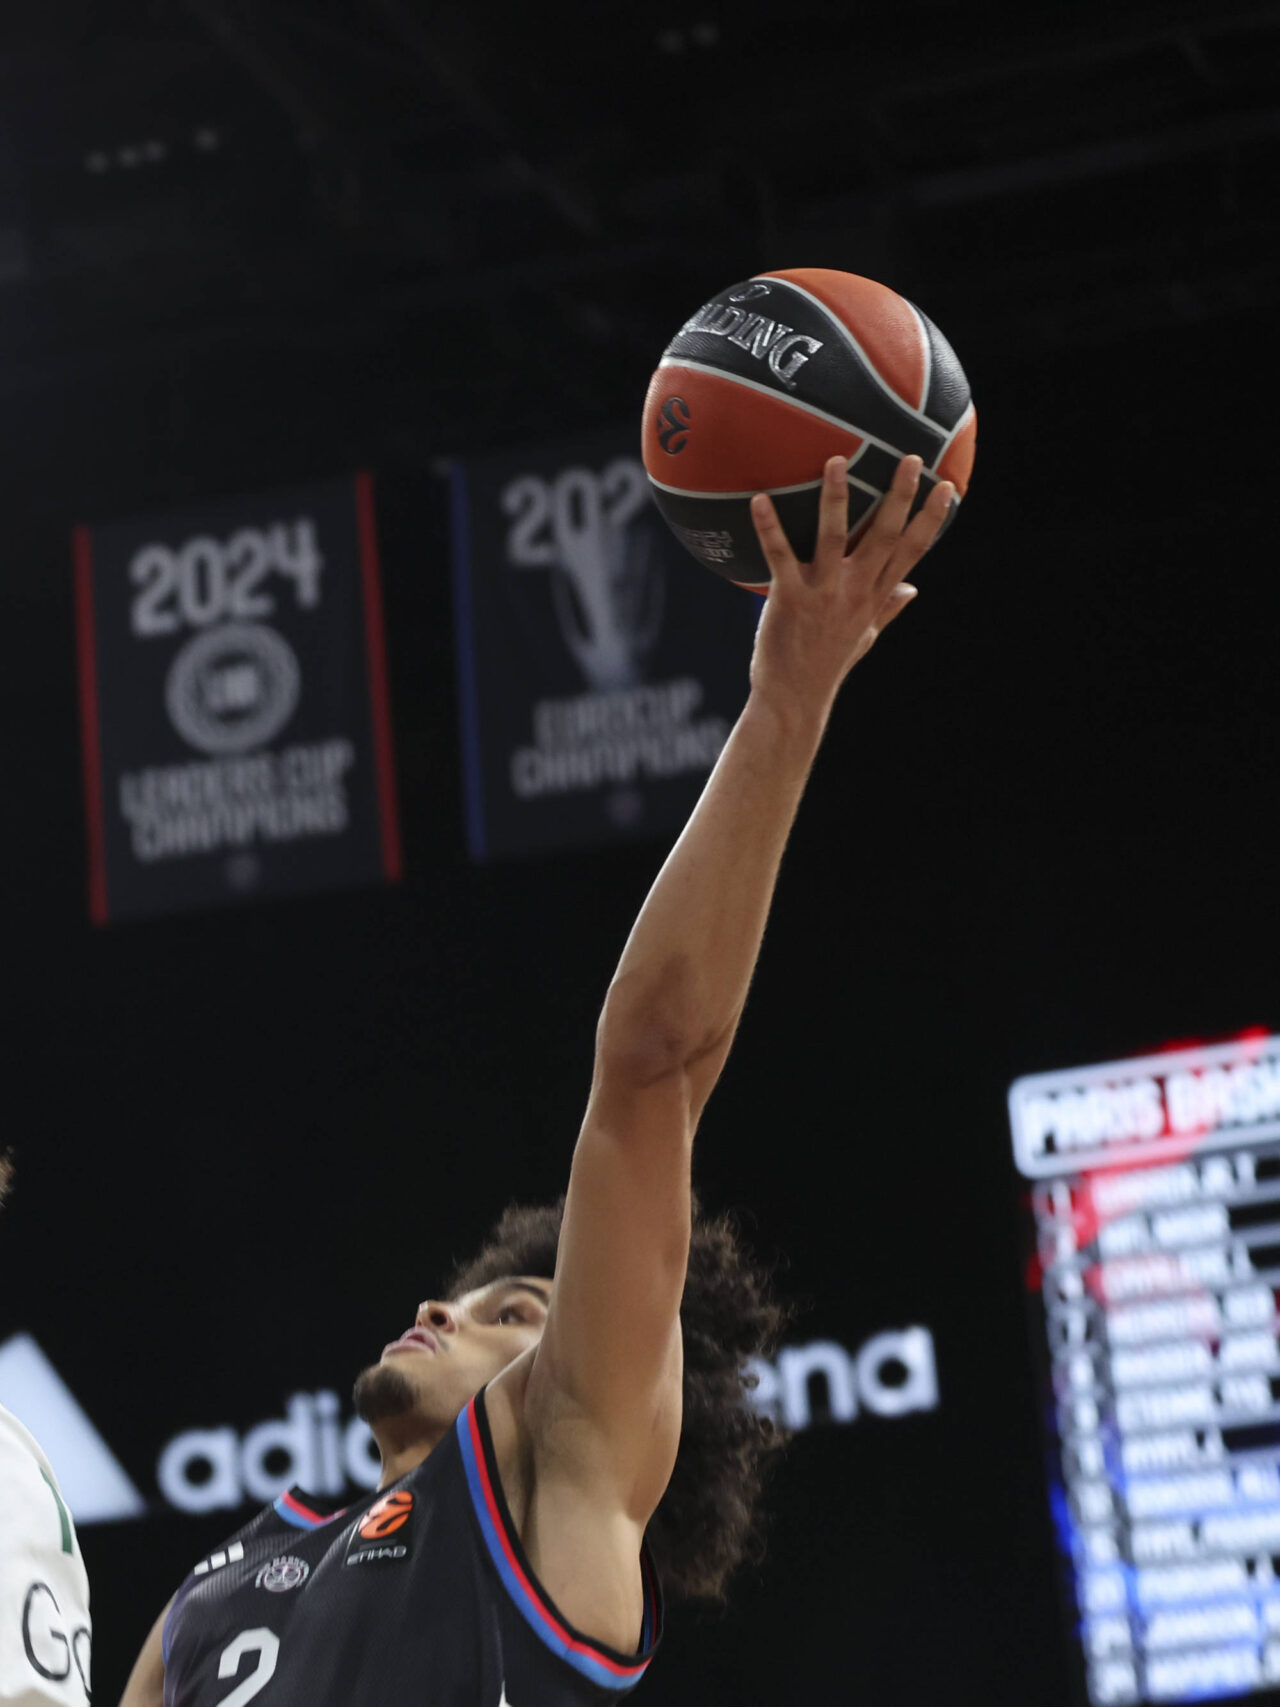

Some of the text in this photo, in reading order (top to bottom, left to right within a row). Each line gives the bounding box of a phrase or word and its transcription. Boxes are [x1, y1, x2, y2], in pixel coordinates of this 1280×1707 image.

[502, 458, 650, 567] 202
[128, 516, 324, 638] 2024
[346, 1544, 408, 1566] ETIHAD
[215, 1626, 280, 1707] 2
